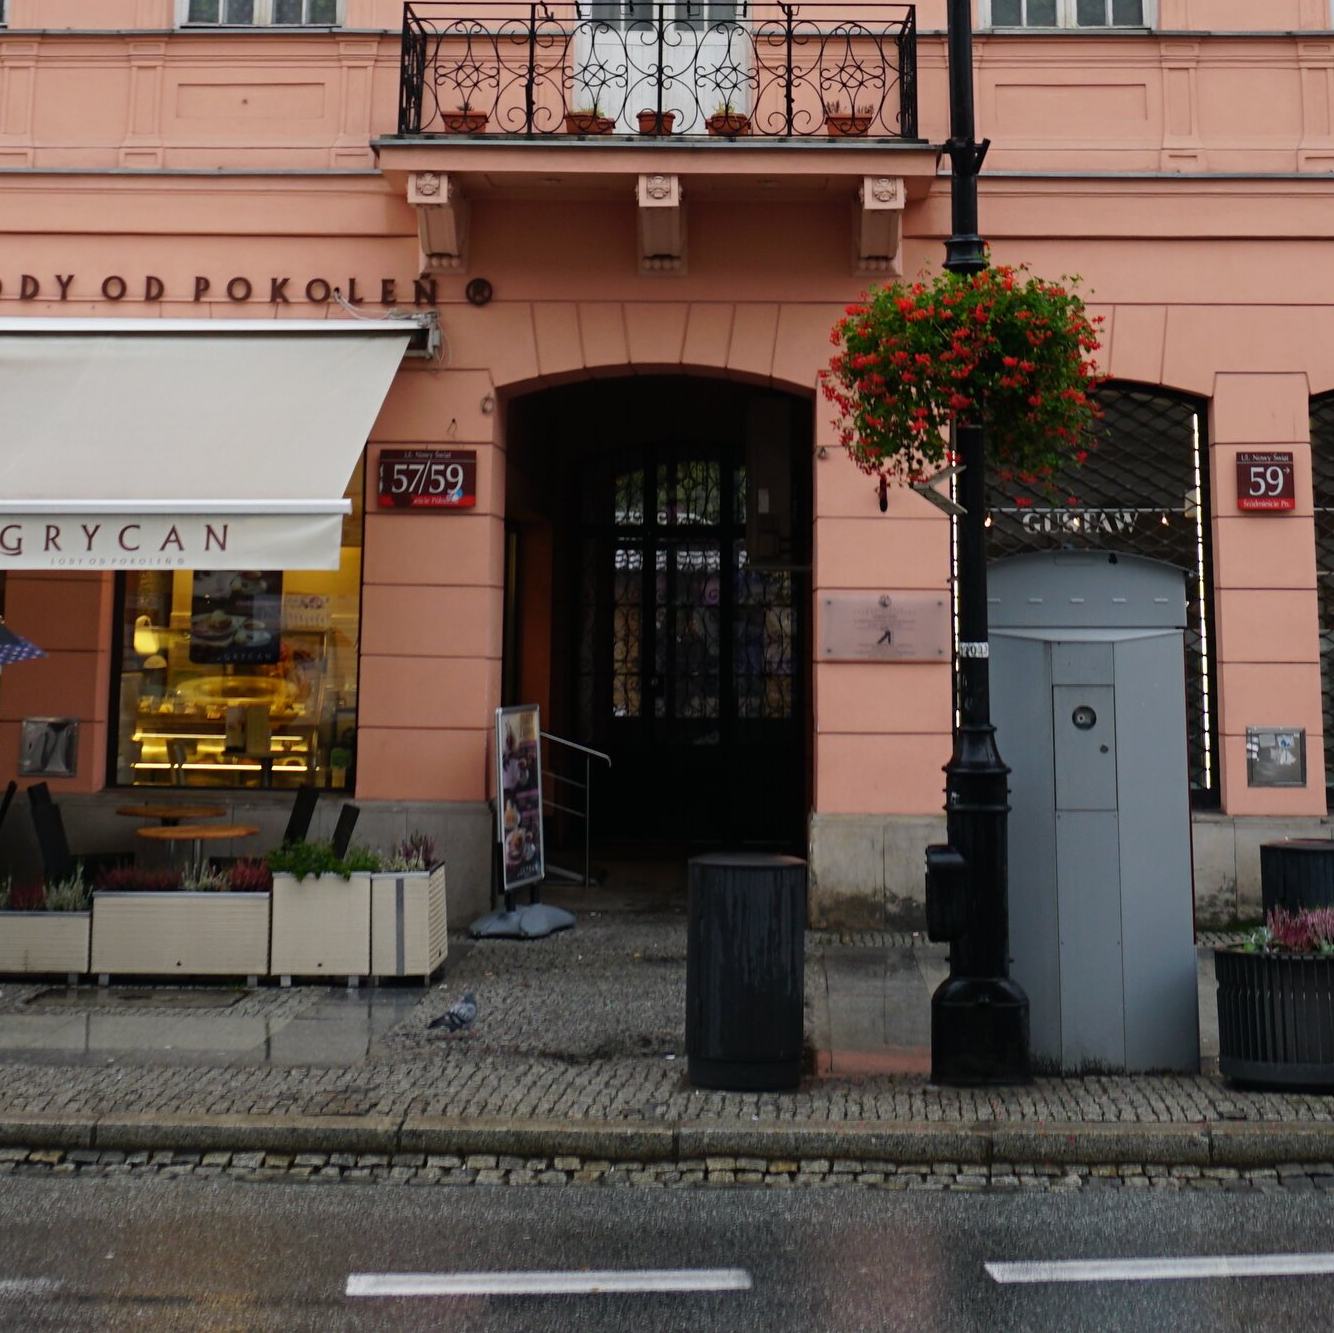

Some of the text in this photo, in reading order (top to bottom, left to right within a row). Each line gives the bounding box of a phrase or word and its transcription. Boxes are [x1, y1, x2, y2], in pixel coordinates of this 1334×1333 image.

[101, 275, 164, 301] OD
[194, 273, 437, 305] POKOLEŃ
[1253, 454, 1271, 462] Nowy
[1273, 452, 1289, 461] Świat
[391, 459, 464, 495] 57/59
[1249, 466, 1284, 496] 59
[1022, 512, 1139, 534] GUSTAW
